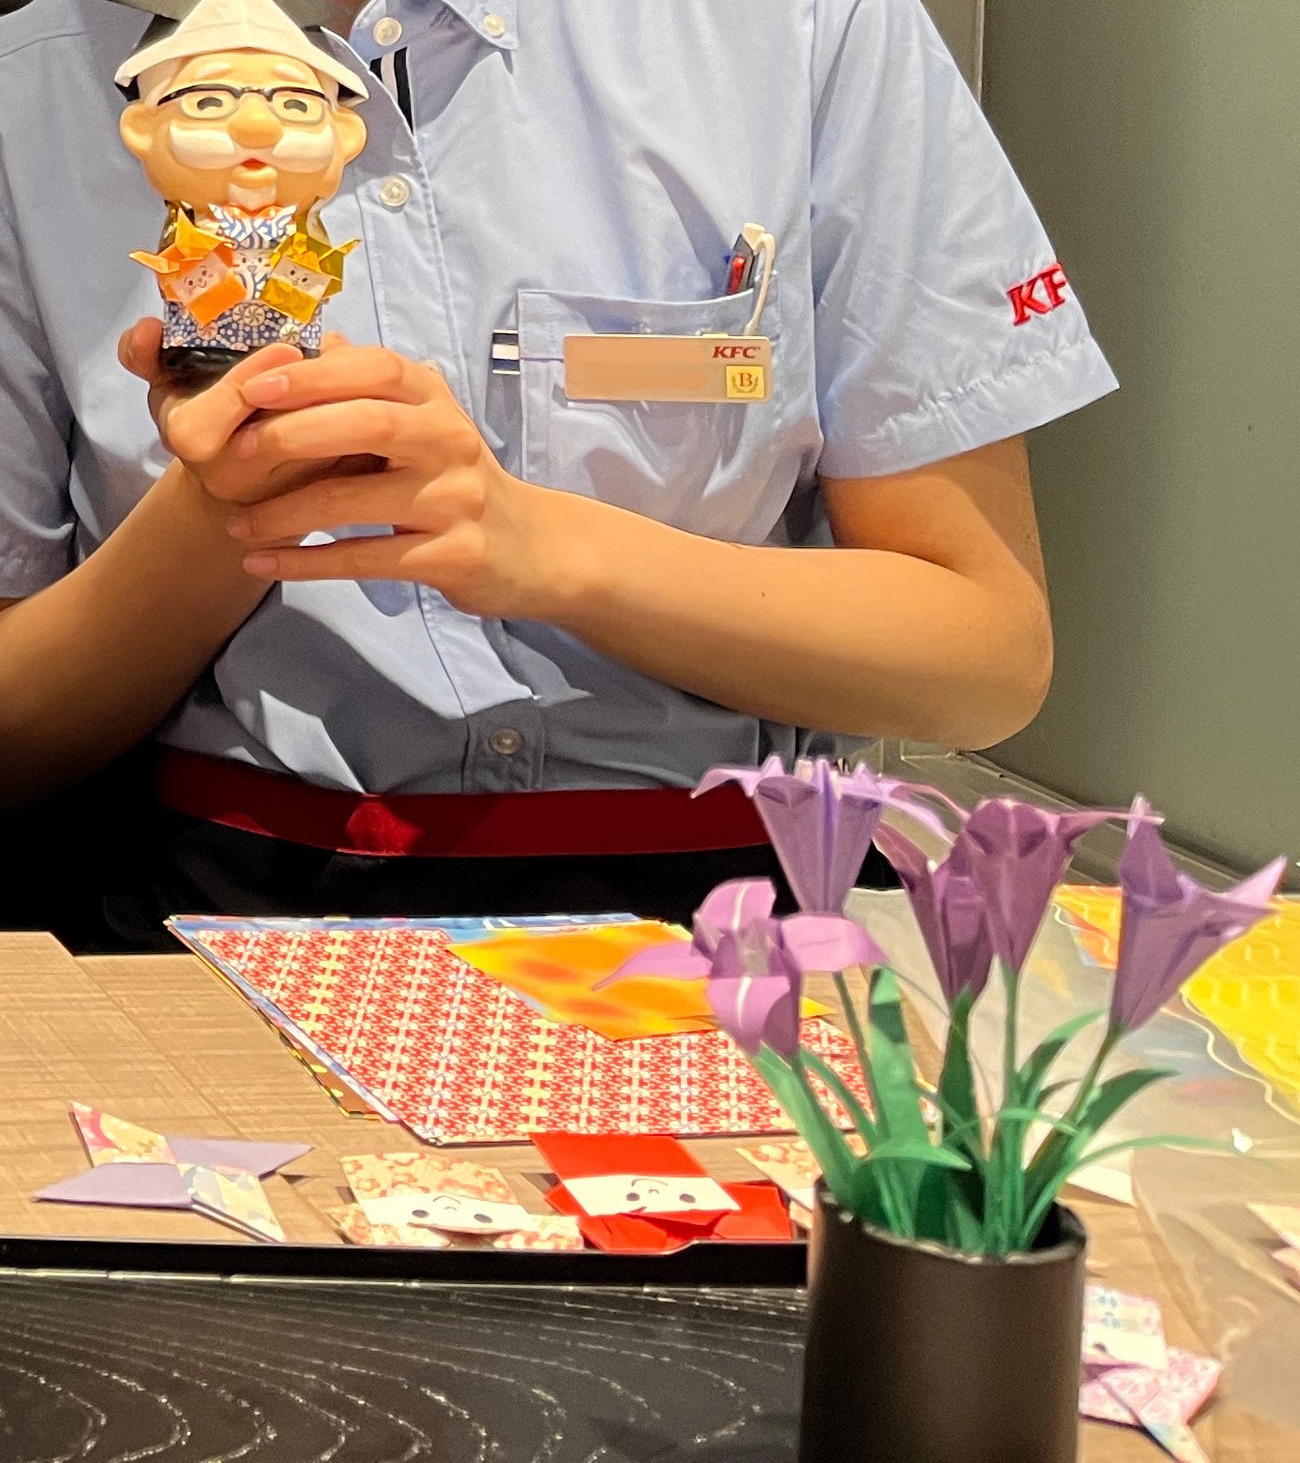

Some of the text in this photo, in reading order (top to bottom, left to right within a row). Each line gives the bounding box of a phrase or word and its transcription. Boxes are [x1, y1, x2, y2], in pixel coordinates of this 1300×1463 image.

[1007, 261, 1067, 326] KF
[712, 345, 757, 359] KFC
[738, 372, 753, 387] B
